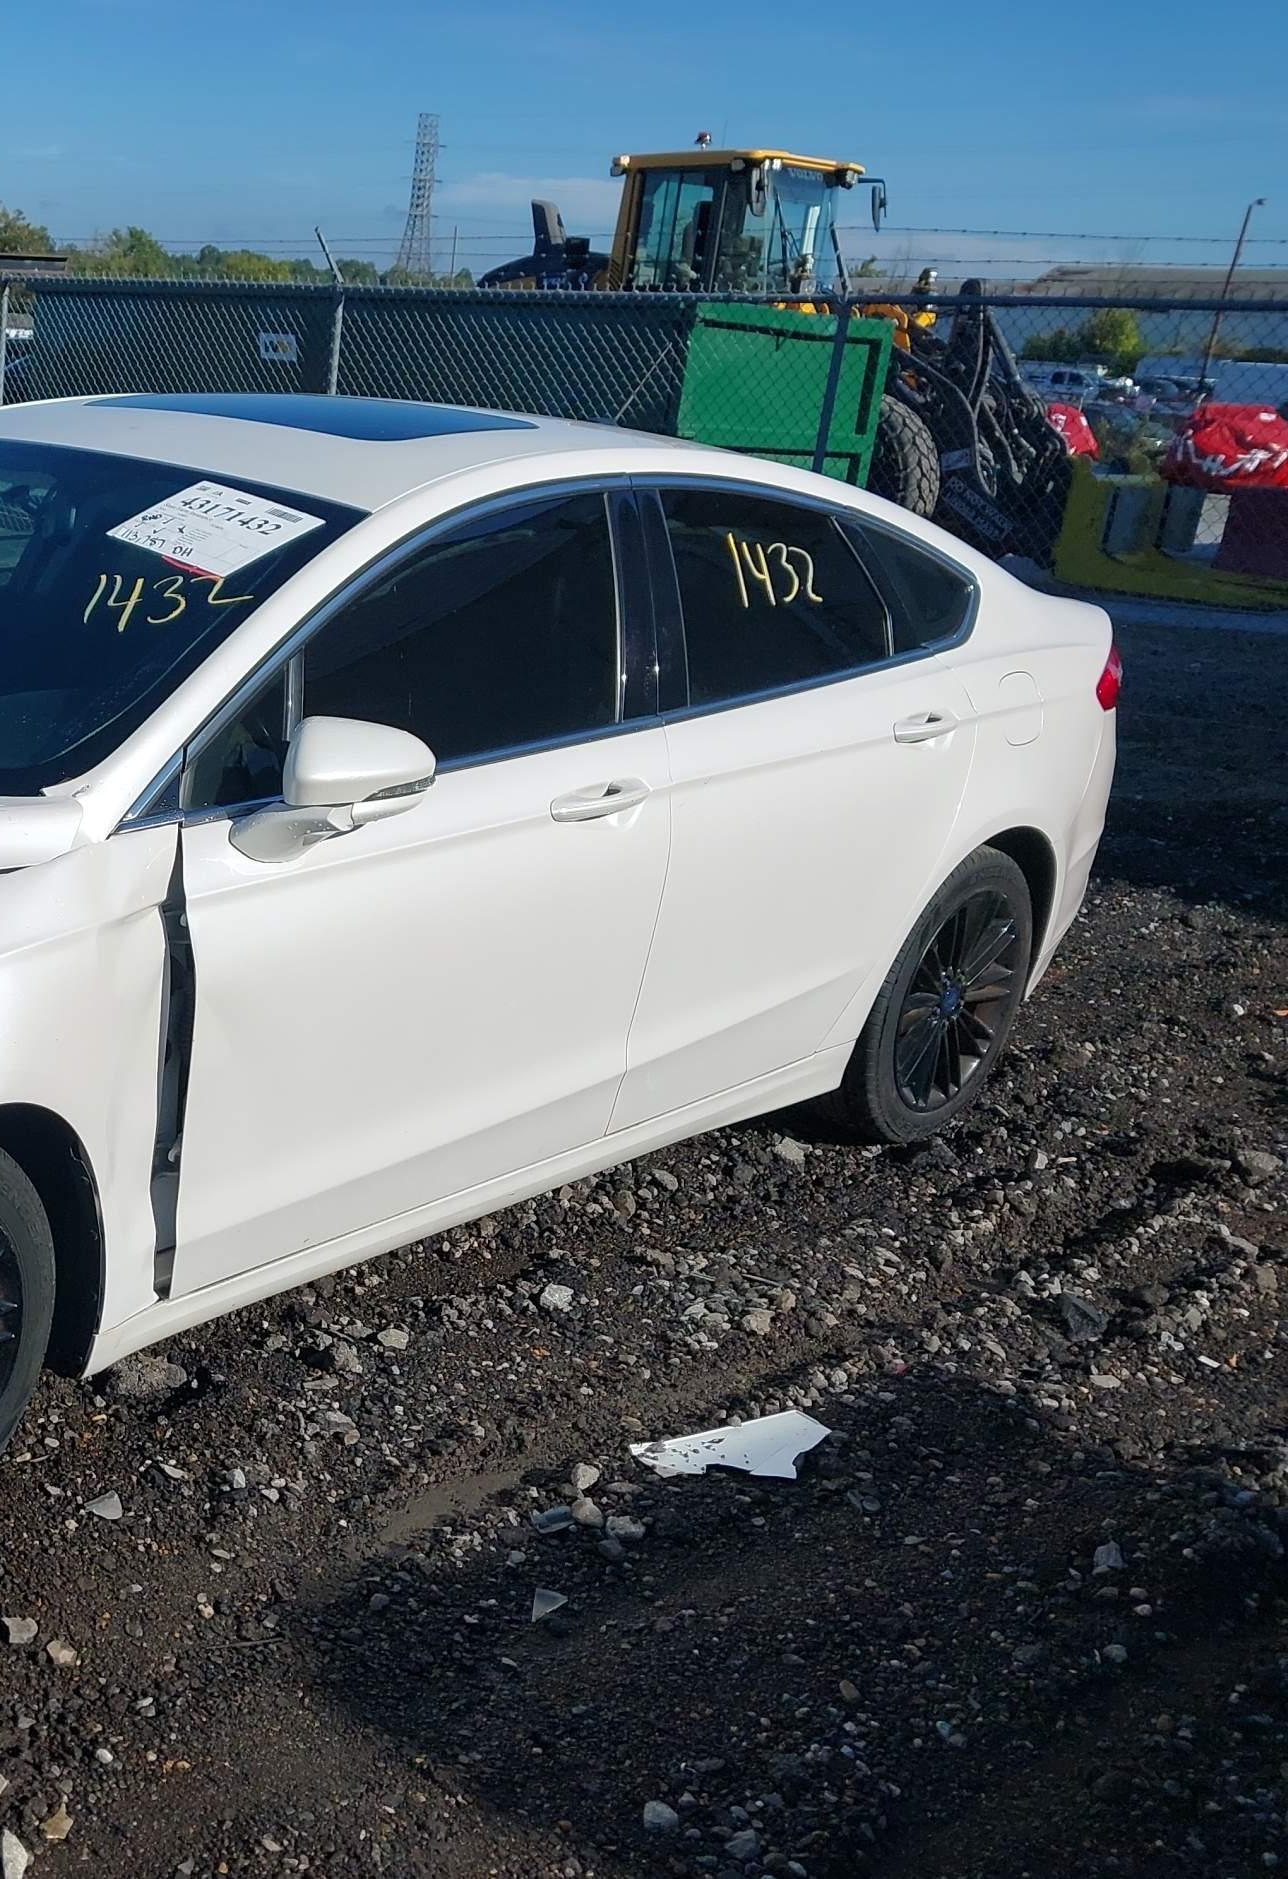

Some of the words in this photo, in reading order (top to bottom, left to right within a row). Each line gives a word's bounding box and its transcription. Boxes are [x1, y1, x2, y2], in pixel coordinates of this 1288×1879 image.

[181, 497, 282, 535] 43171432
[727, 533, 823, 608] 1432
[83, 574, 255, 633] 1432
